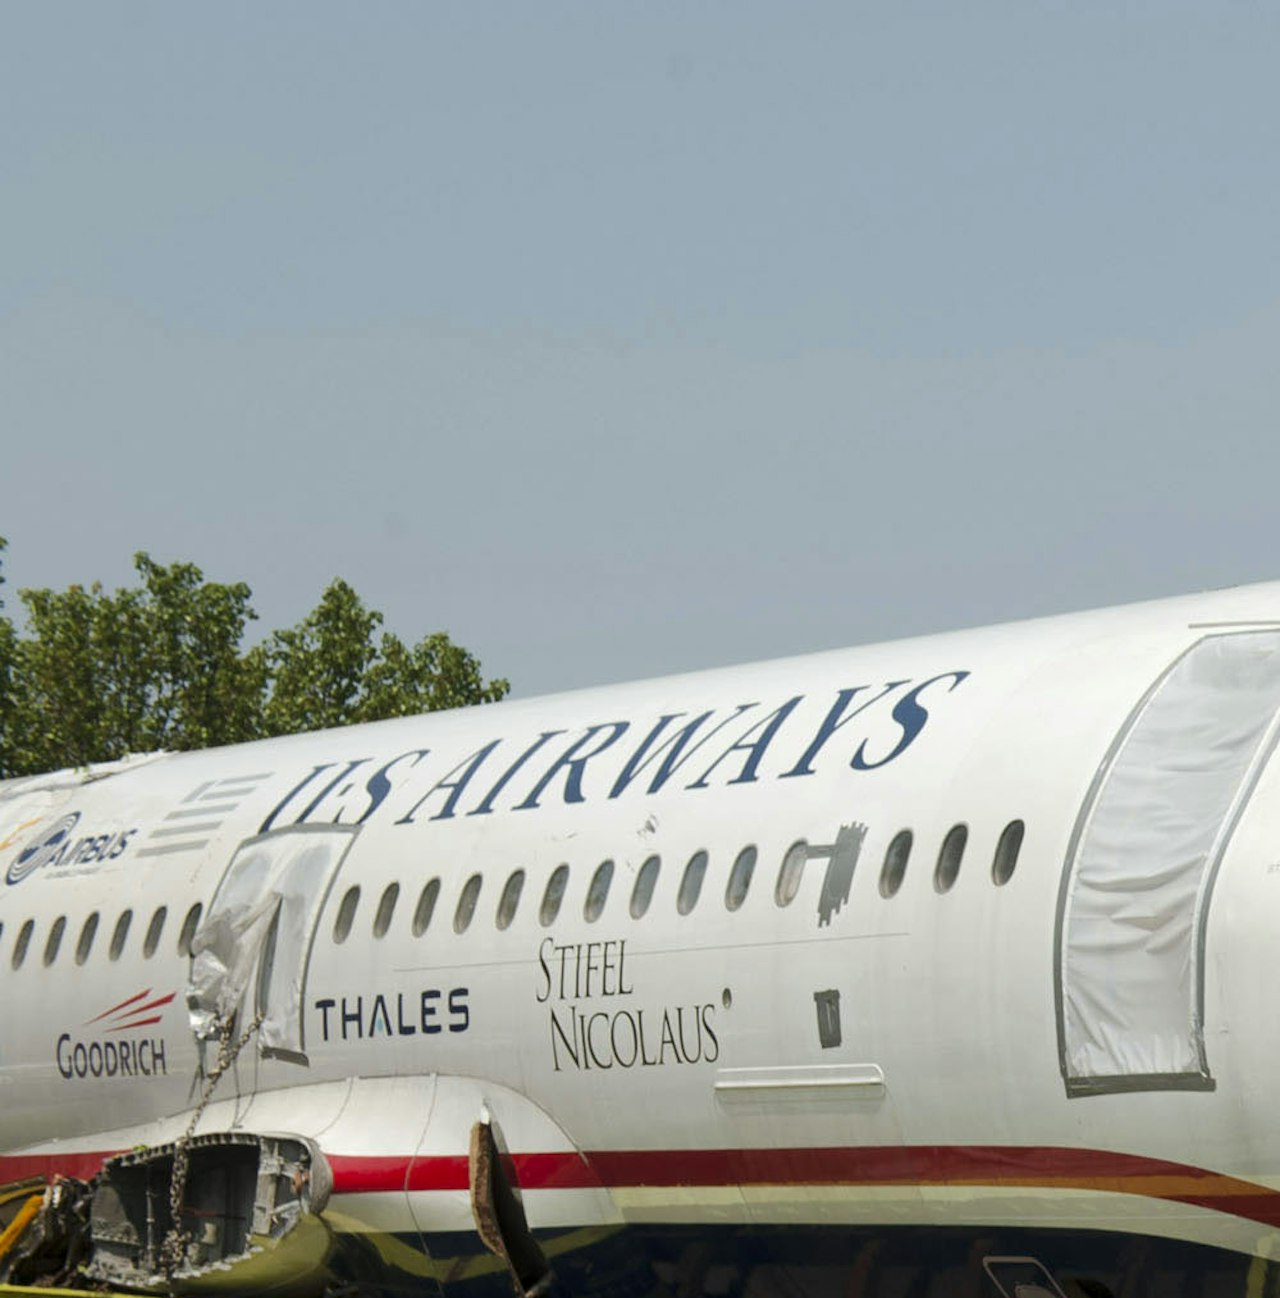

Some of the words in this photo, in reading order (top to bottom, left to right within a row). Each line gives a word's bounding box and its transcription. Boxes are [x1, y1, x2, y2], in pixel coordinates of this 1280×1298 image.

[393, 670, 972, 826] AIRWAYS
[535, 936, 634, 1003] STIFEL
[315, 987, 470, 1041] THALES
[550, 1003, 719, 1072] NICOLAUS
[56, 1032, 168, 1080] GOODRICH
